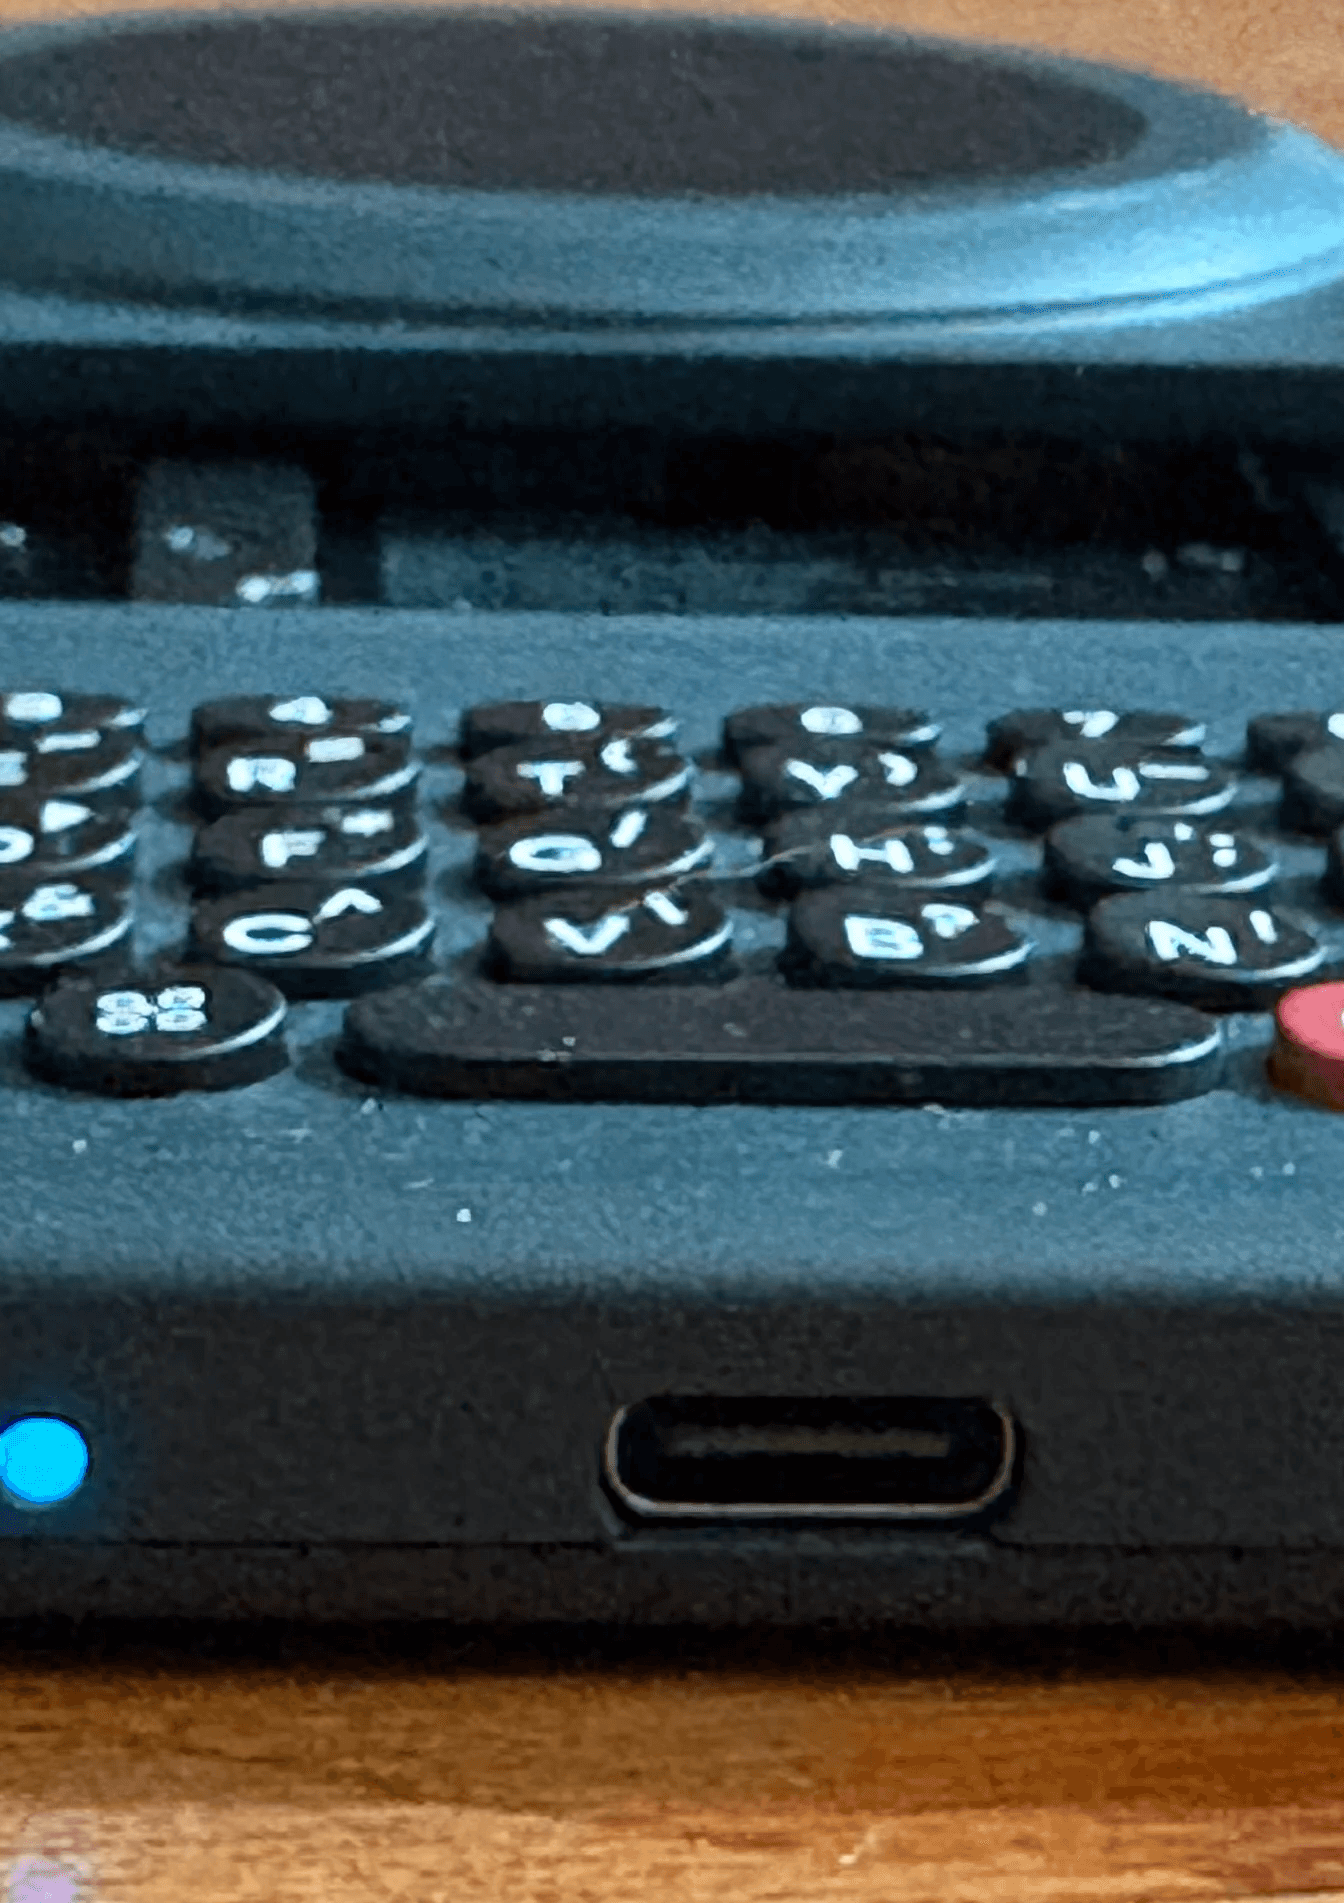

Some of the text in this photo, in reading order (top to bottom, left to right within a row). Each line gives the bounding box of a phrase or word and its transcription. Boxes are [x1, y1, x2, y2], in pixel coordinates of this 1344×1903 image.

[516, 760, 585, 797] T
[785, 758, 859, 800] Y
[1062, 761, 1141, 802] U
[261, 829, 326, 869] F
[829, 832, 915, 874] H
[1111, 841, 1176, 880] J
[221, 913, 313, 955] C
[542, 914, 631, 955] V
[843, 914, 925, 960] B
[1146, 919, 1238, 966] N
